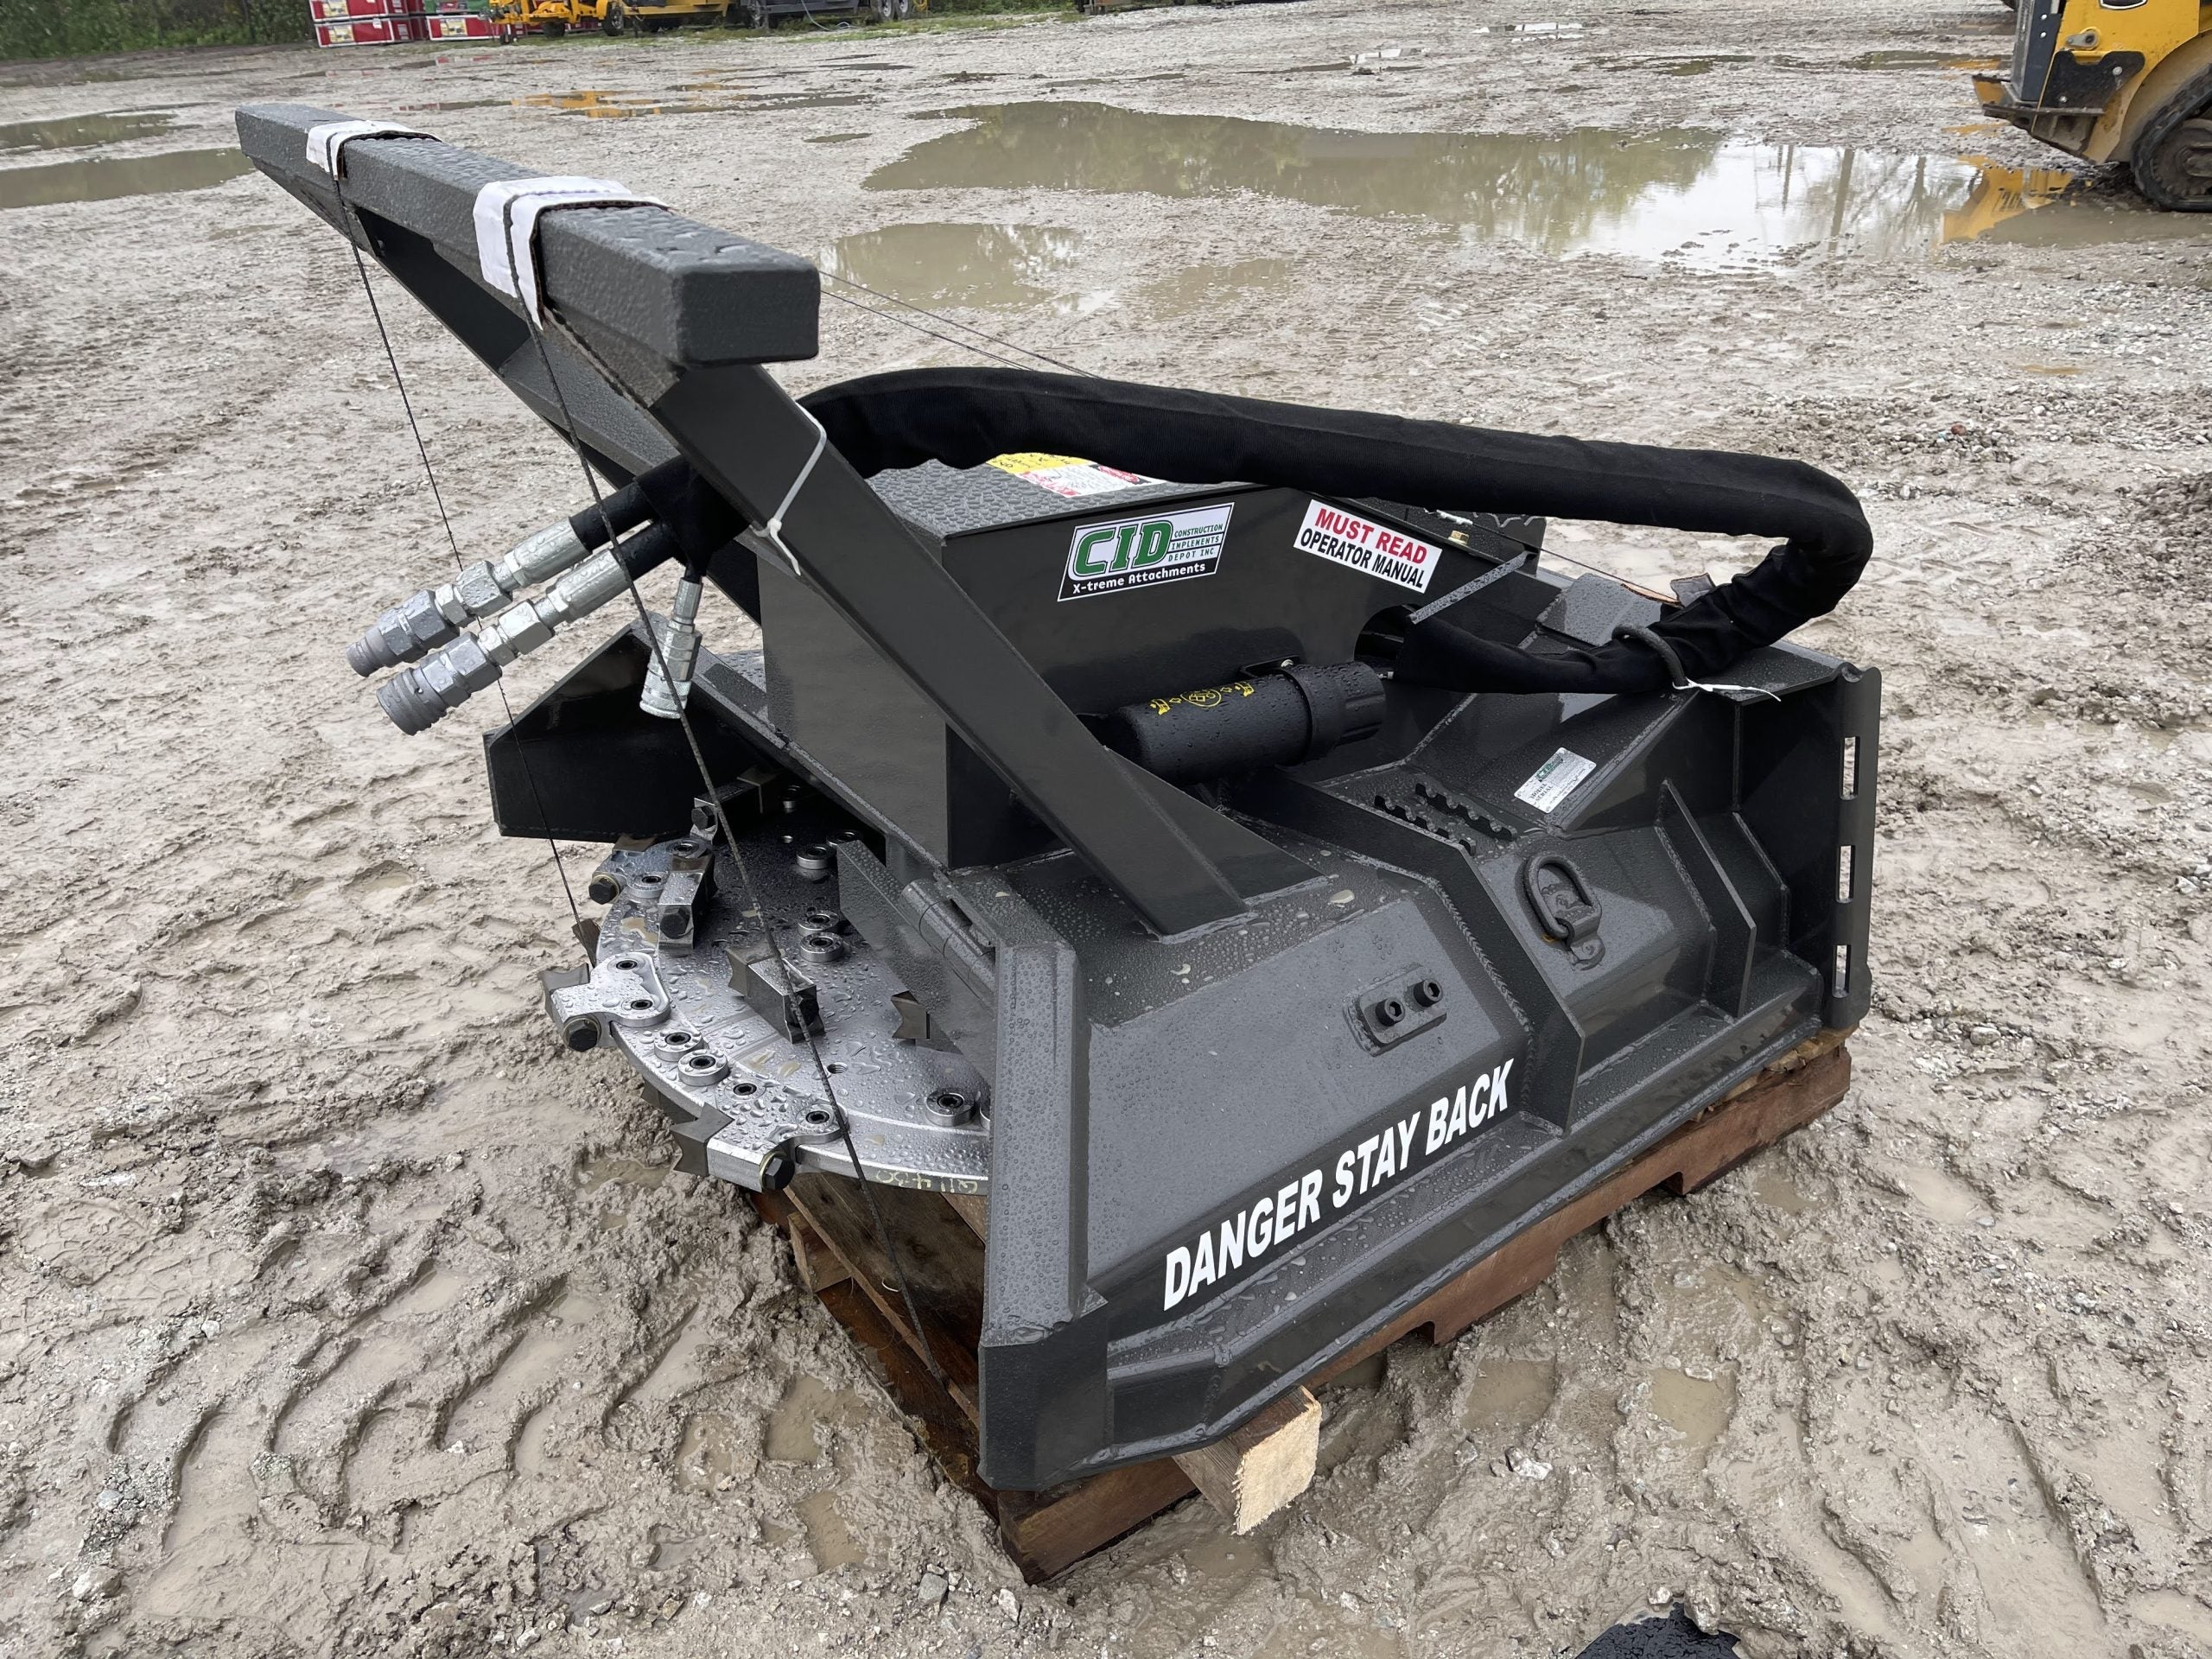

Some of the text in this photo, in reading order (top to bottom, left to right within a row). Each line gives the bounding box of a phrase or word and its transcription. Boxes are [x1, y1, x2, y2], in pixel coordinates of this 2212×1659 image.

[1073, 520, 1173, 577] CID
[1171, 536, 1219, 550] IMPLEMENTS
[1174, 524, 1224, 538] CONSTRUCTION
[1314, 507, 1427, 564] MUST READ
[1168, 548, 1215, 563] DEPOT INC
[1300, 528, 1425, 588] OPERATOR MANUAL
[1072, 563, 1205, 594] X-treme Attachments
[1163, 1058, 1515, 1312] DANGER STAY BACK
